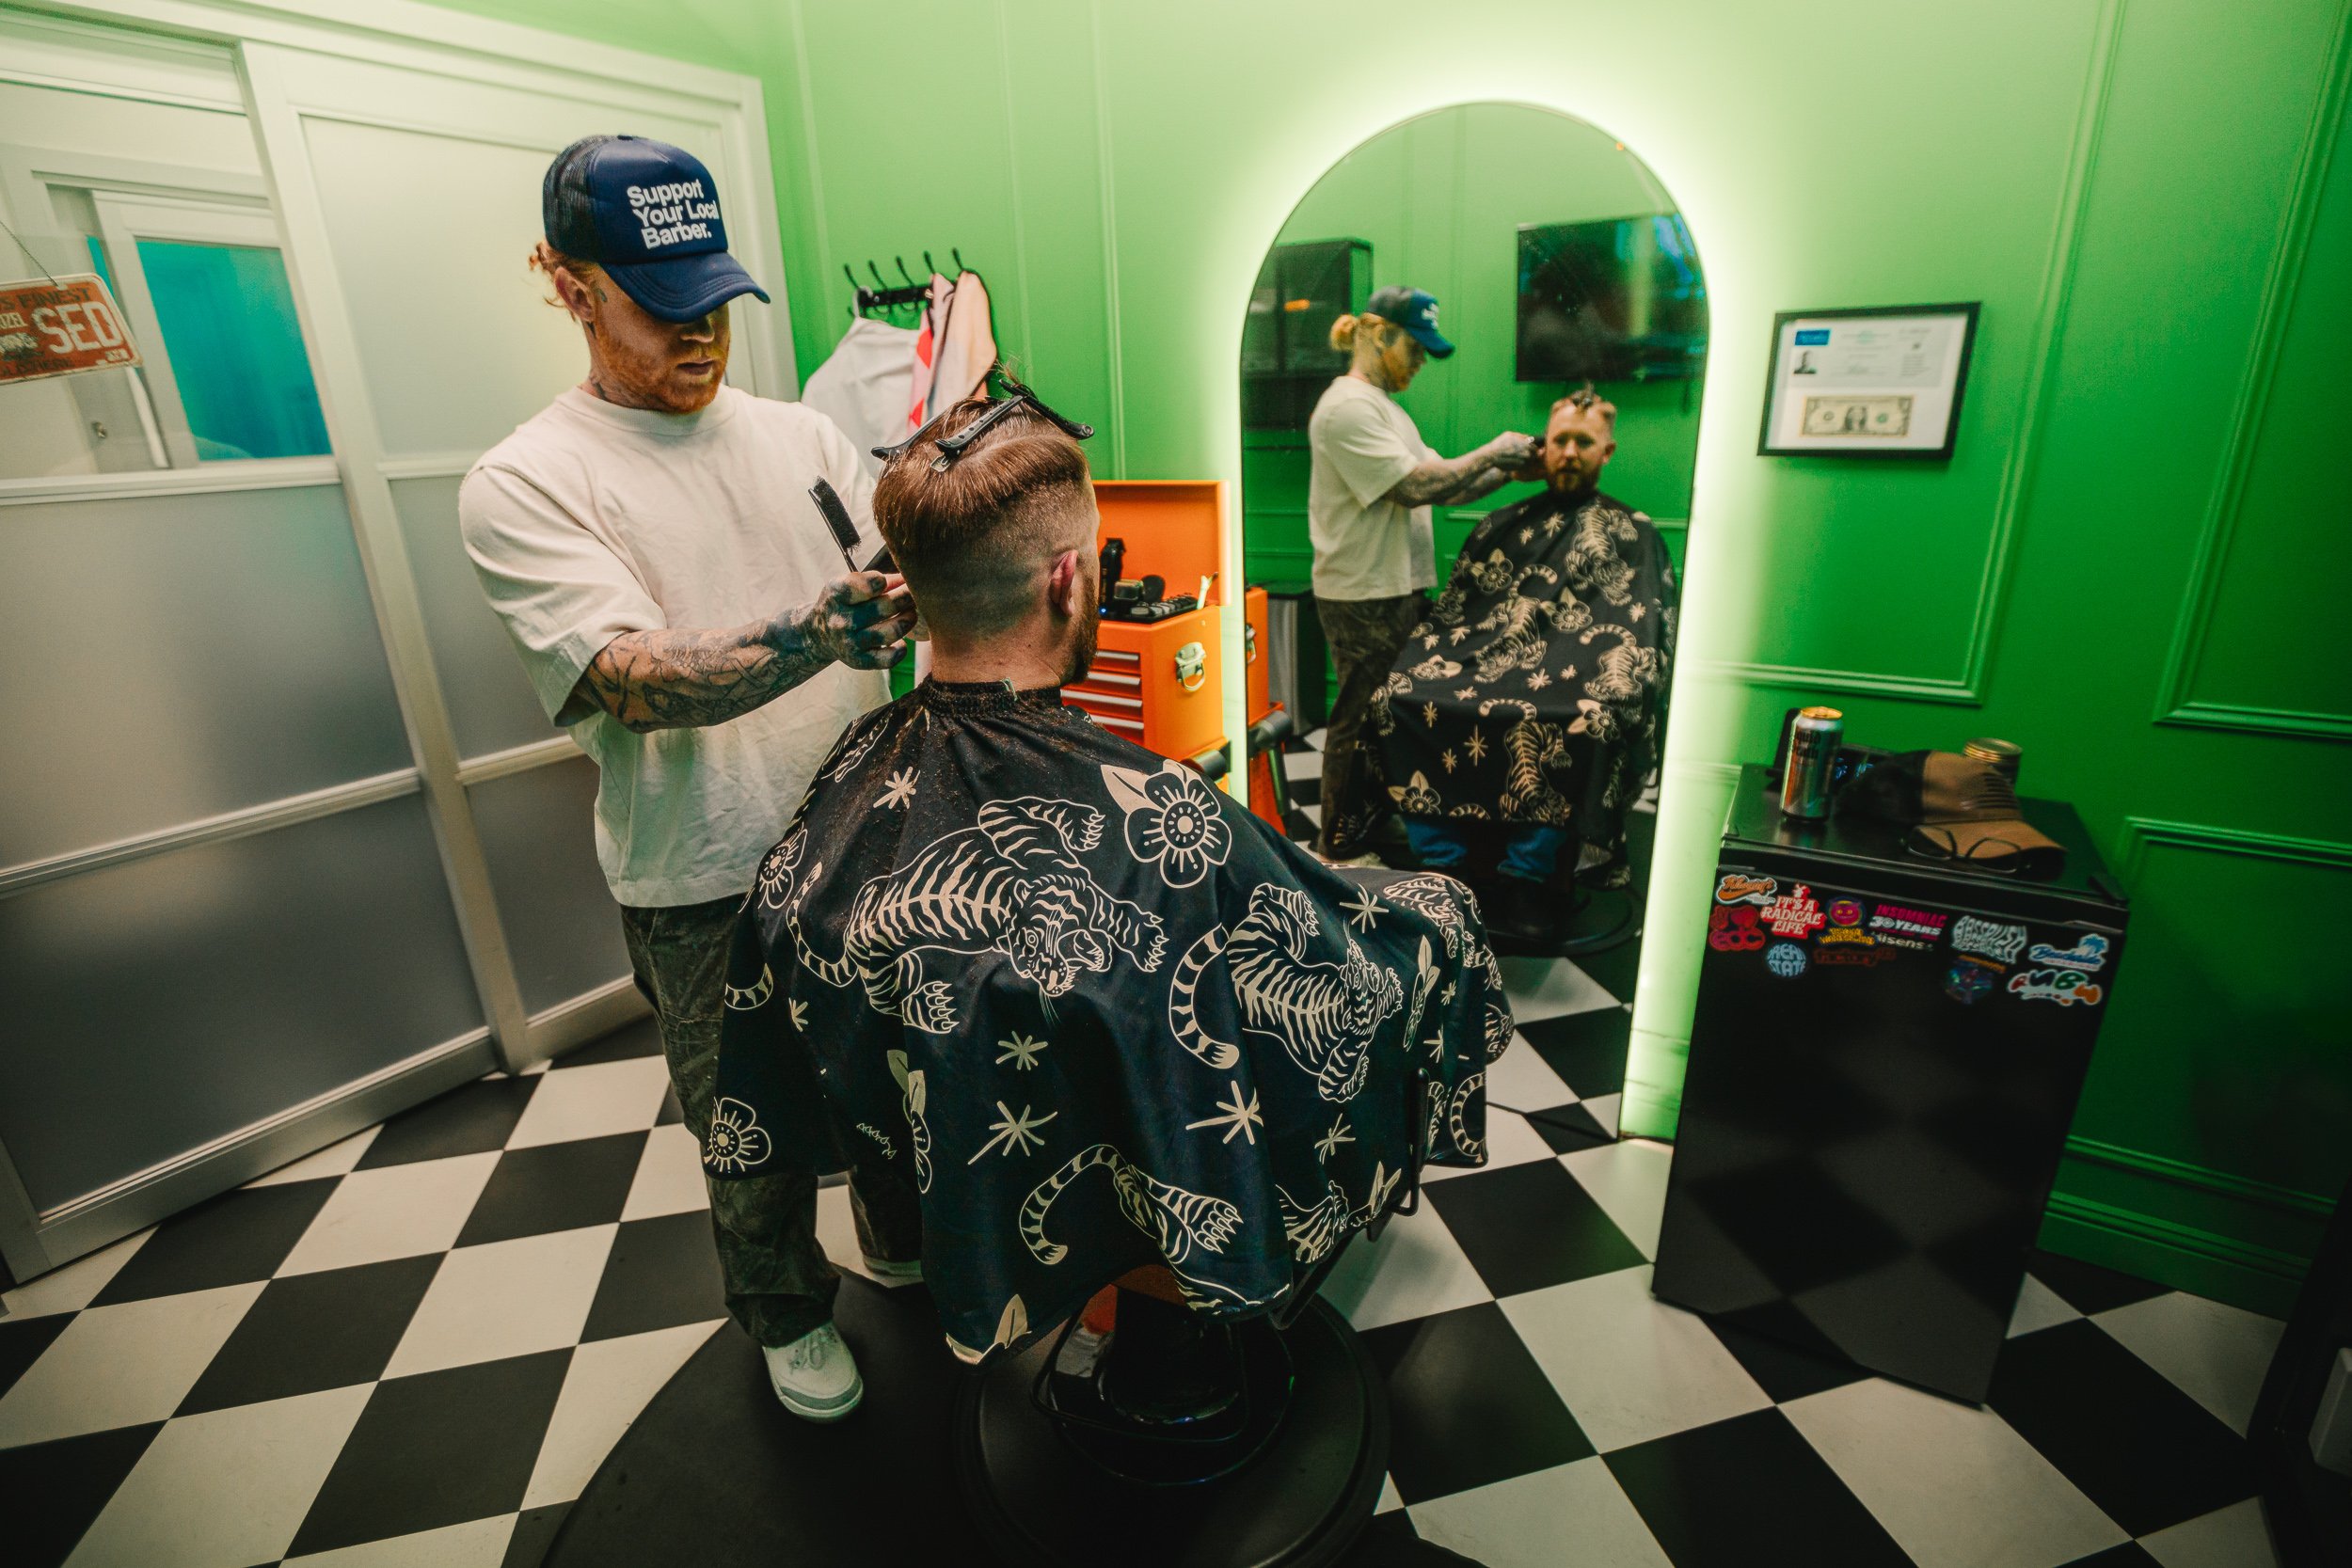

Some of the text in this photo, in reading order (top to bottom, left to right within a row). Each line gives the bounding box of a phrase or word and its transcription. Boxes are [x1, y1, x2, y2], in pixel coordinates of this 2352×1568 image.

[627, 179, 704, 207] Support
[632, 206, 684, 227] Your
[641, 222, 712, 249] Barber.
[1804, 899, 1815, 911] A
[1760, 906, 1822, 925] RADICAL
[1874, 904, 1948, 927] INSOMNIAC
[1772, 920, 1804, 934] LIFE
[1895, 919, 1942, 935] YEARS
